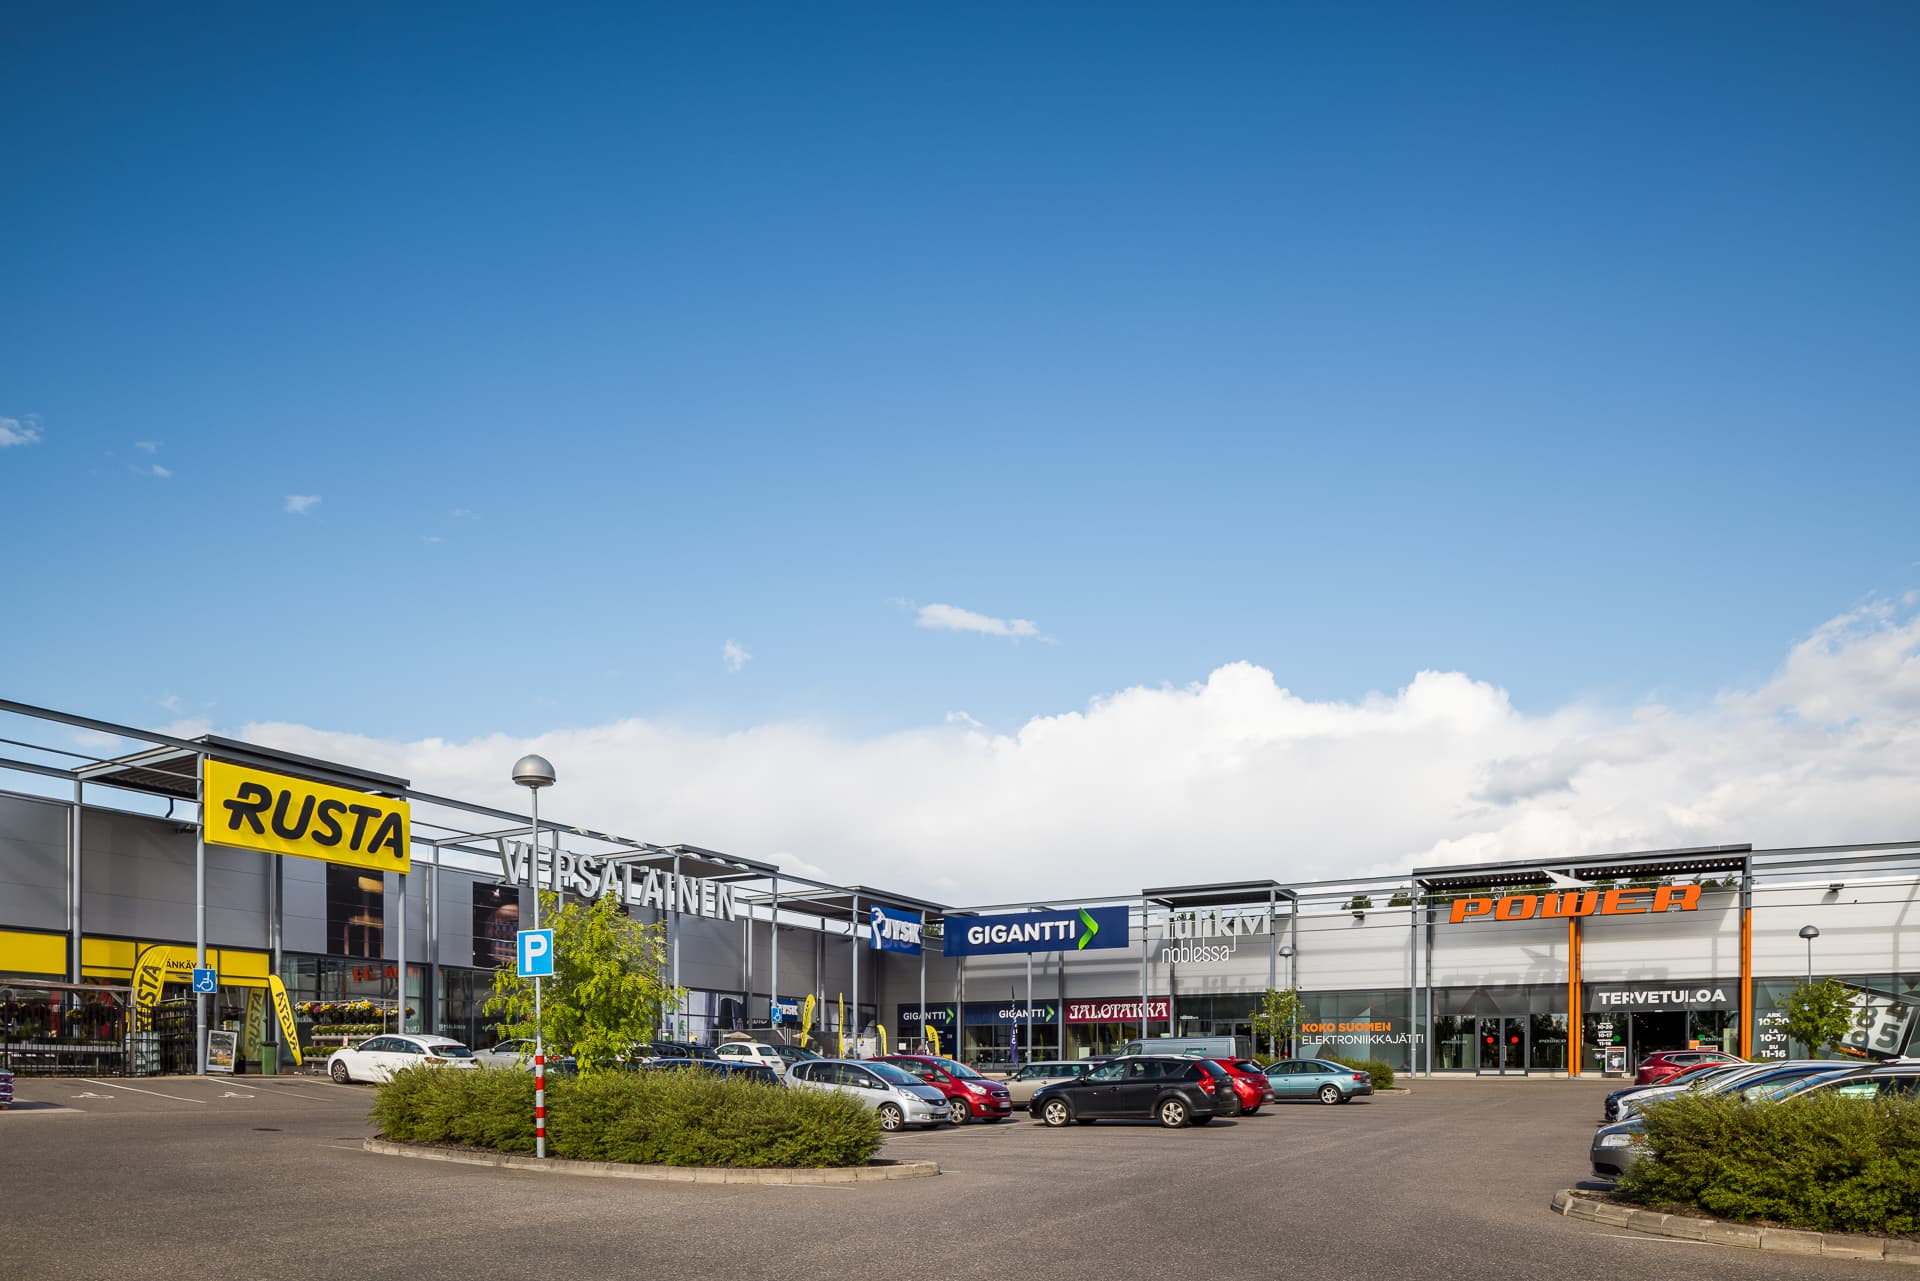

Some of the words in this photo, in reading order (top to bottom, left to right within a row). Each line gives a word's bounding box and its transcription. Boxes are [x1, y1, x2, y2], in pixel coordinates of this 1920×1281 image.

[223, 781, 404, 859] RUSTA
[1449, 884, 1702, 925] POWER
[881, 917, 922, 944] JYSK
[967, 919, 1076, 945] GIGANTTI
[524, 934, 547, 972] P
[1162, 938, 1231, 964] noblessa
[1598, 989, 1727, 1005] TERVETULOA
[999, 1009, 1045, 1018] GIGANTTI
[1069, 1002, 1168, 1019] JALOTAKKA
[1302, 1022, 1336, 1033] KOKO
[1338, 1021, 1392, 1032] SUOMEN
[1302, 1032, 1424, 1045] ELEKTRONIIKKAJÄTTI
[1759, 1033, 1788, 1042] 10-17
[1761, 1050, 1787, 1058] 11-16
